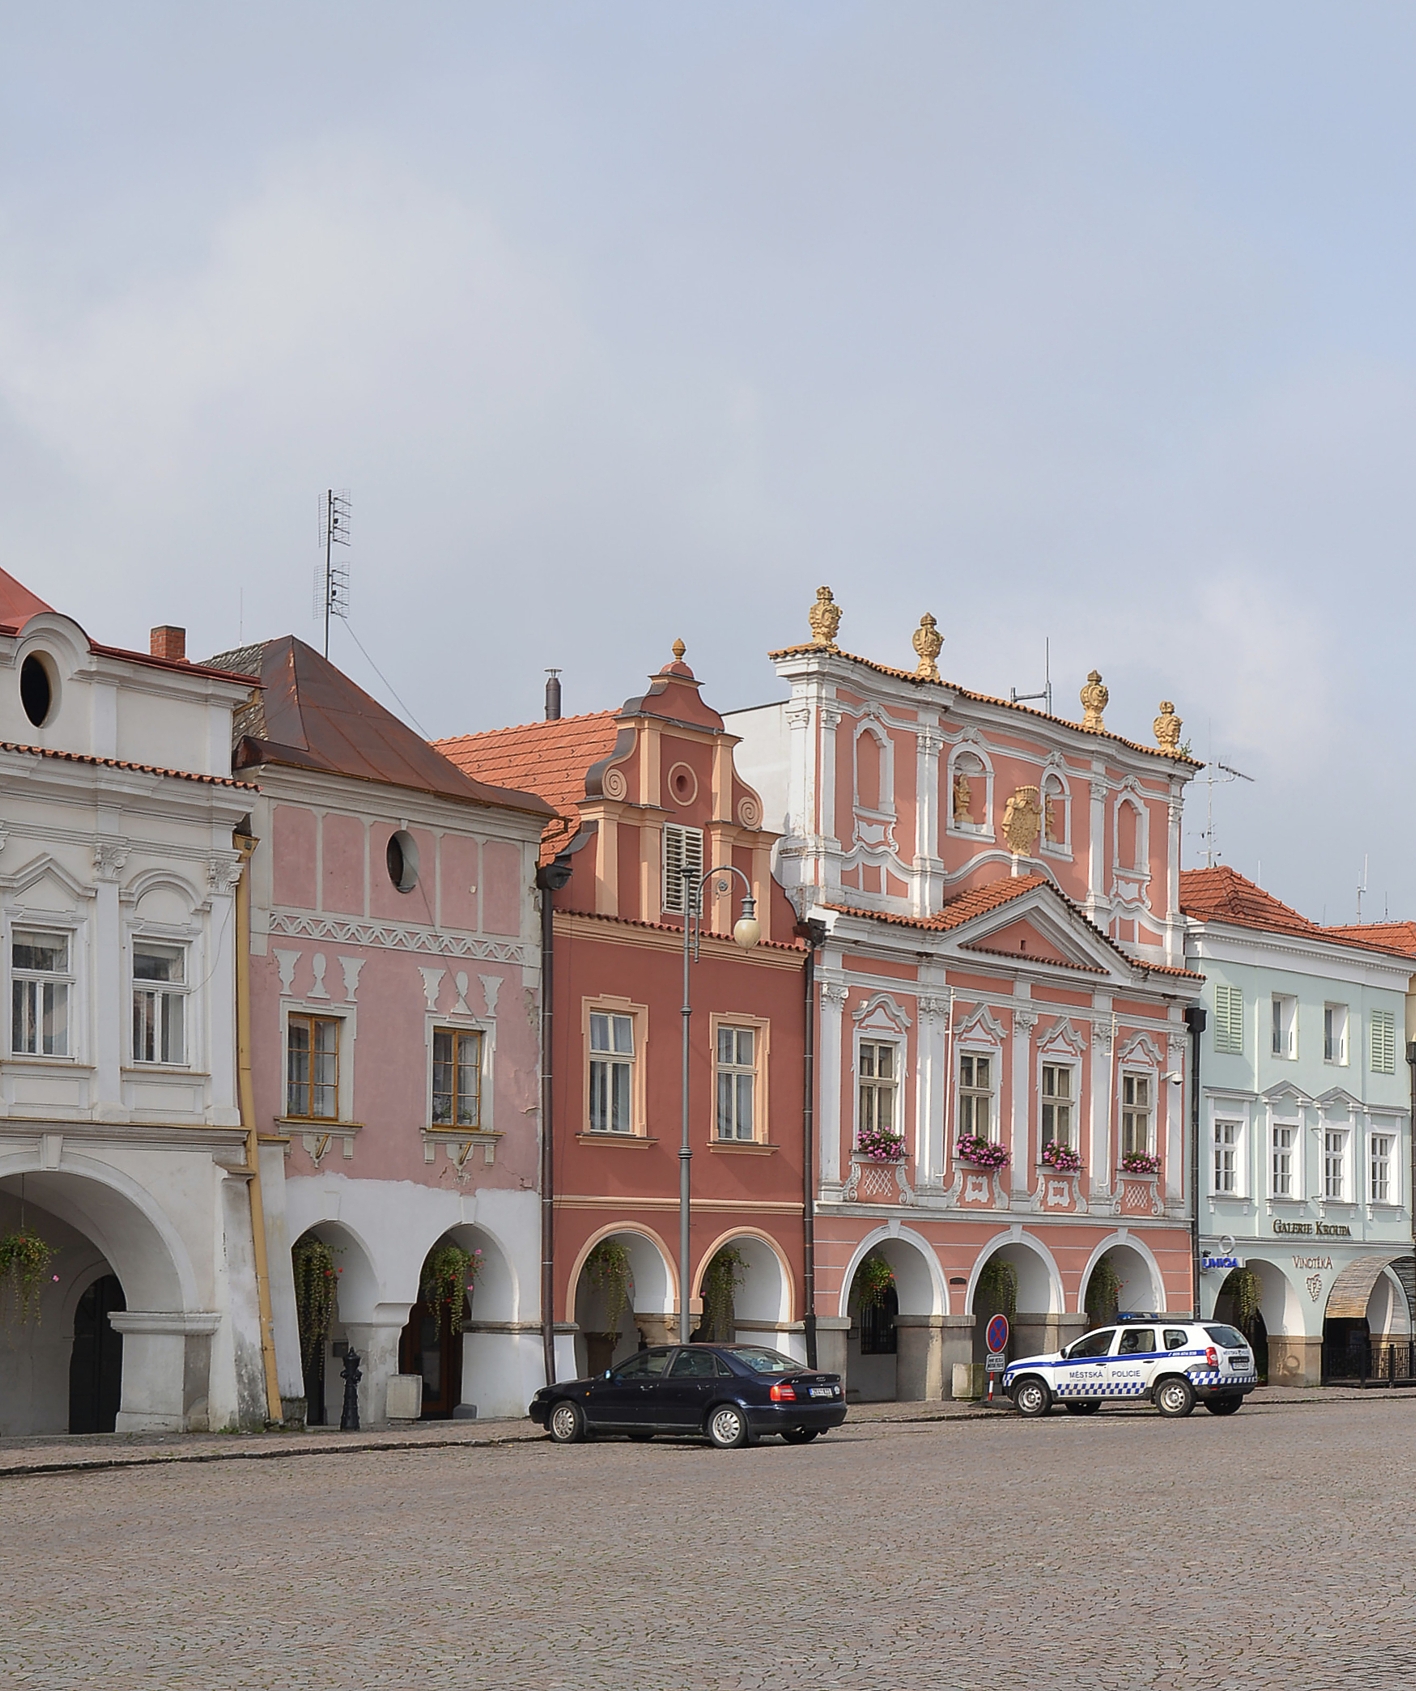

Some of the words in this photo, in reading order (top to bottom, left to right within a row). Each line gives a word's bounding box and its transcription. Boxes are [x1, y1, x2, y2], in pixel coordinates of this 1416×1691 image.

[1202, 1257, 1239, 1269] UNIQA
[1069, 1369, 1104, 1379] MĚSTSKÁ
[1111, 1369, 1142, 1378] POLICIE
